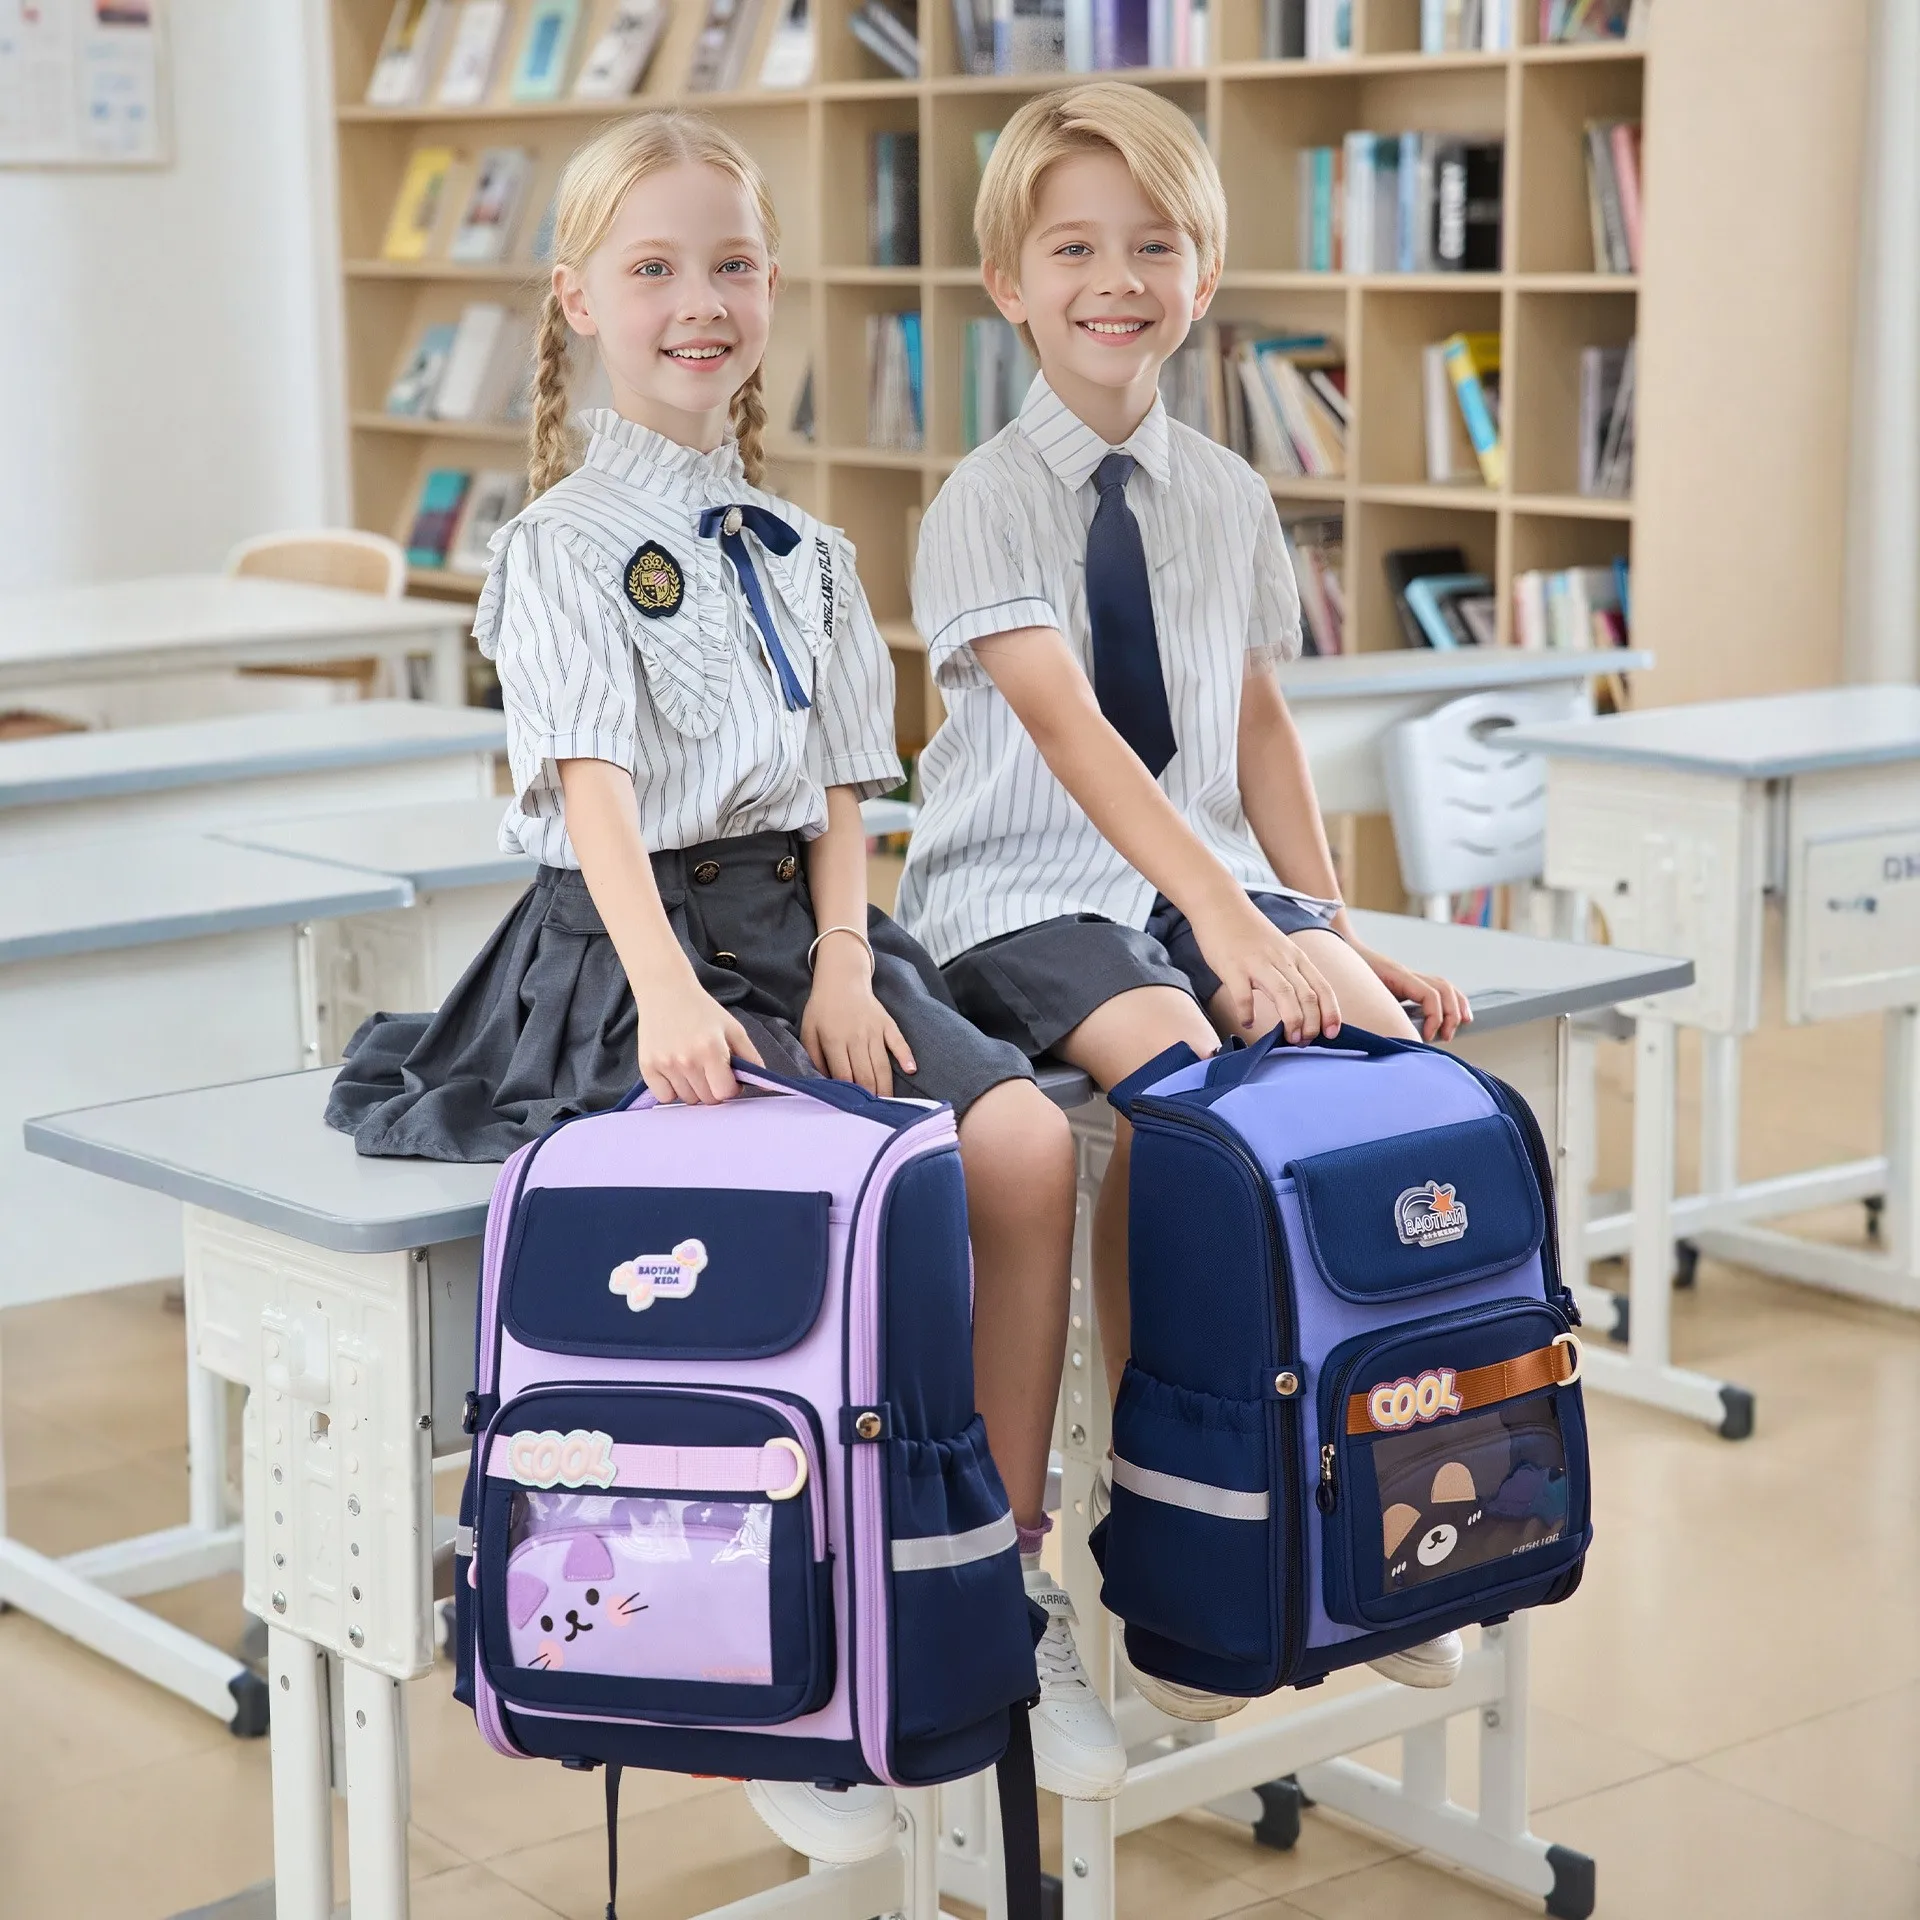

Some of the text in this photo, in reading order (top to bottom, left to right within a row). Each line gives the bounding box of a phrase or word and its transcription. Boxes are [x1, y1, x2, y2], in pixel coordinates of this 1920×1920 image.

[821, 573, 834, 639] ENGLAND
[1404, 1207, 1465, 1236] BAOTIAN
[1437, 1226, 1461, 1237] KEDA
[638, 1266, 681, 1275] BAOTIAN
[654, 1276, 680, 1285] KEDA
[1371, 1373, 1460, 1426] COOL
[513, 1437, 611, 1483] COOL
[1512, 1532, 1560, 1555] FASHION
